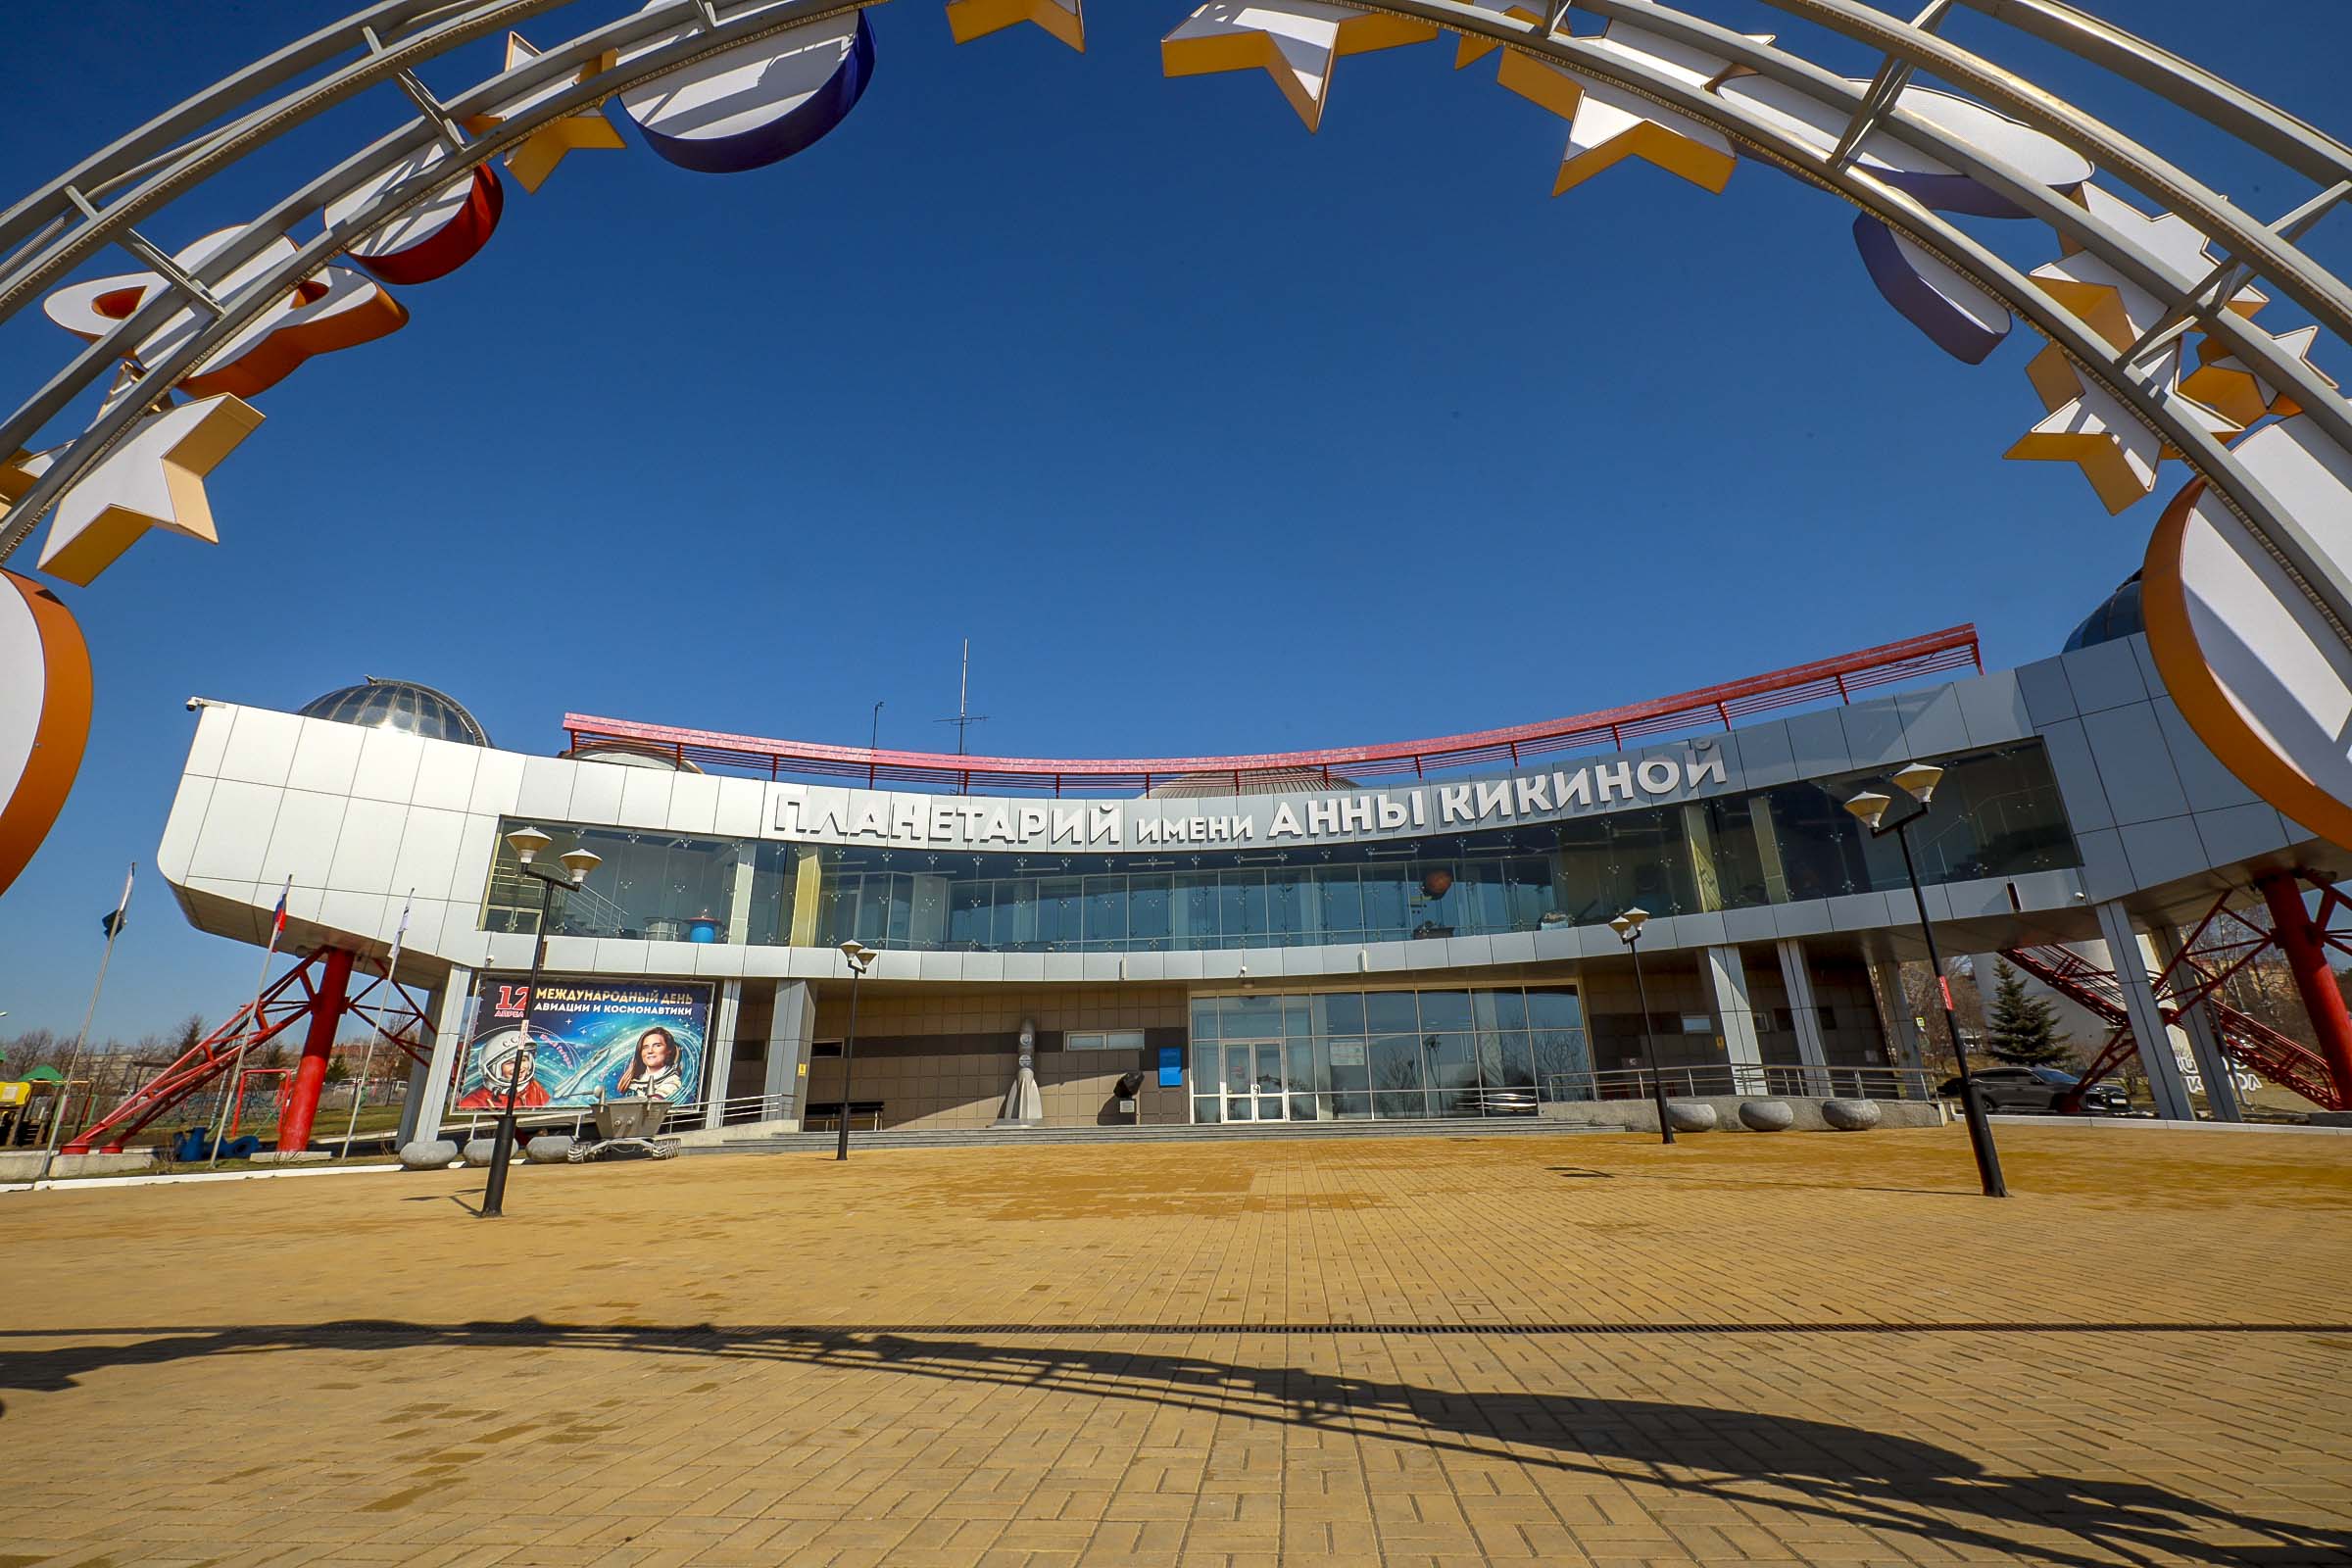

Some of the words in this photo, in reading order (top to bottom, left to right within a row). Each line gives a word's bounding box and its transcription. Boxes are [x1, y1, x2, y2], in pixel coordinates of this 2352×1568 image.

[774, 793, 1121, 846] ПЛАНЕТАРИЙ
[1137, 813, 1253, 845] ИМЕНИ
[1267, 791, 1425, 838] АННЫ
[1441, 740, 1728, 823] КИКИНОЙ
[495, 985, 530, 1010] 12
[535, 987, 660, 1004] МЕЖДУНАРОДНЫЙ
[661, 993, 693, 1005] ДЕНЬ
[494, 1009, 524, 1018] АПРЕЛ
[533, 1002, 590, 1012] АВИАЦИИ
[592, 1004, 602, 1013] И
[603, 1004, 693, 1016] КОСМОНАВТИКИ
